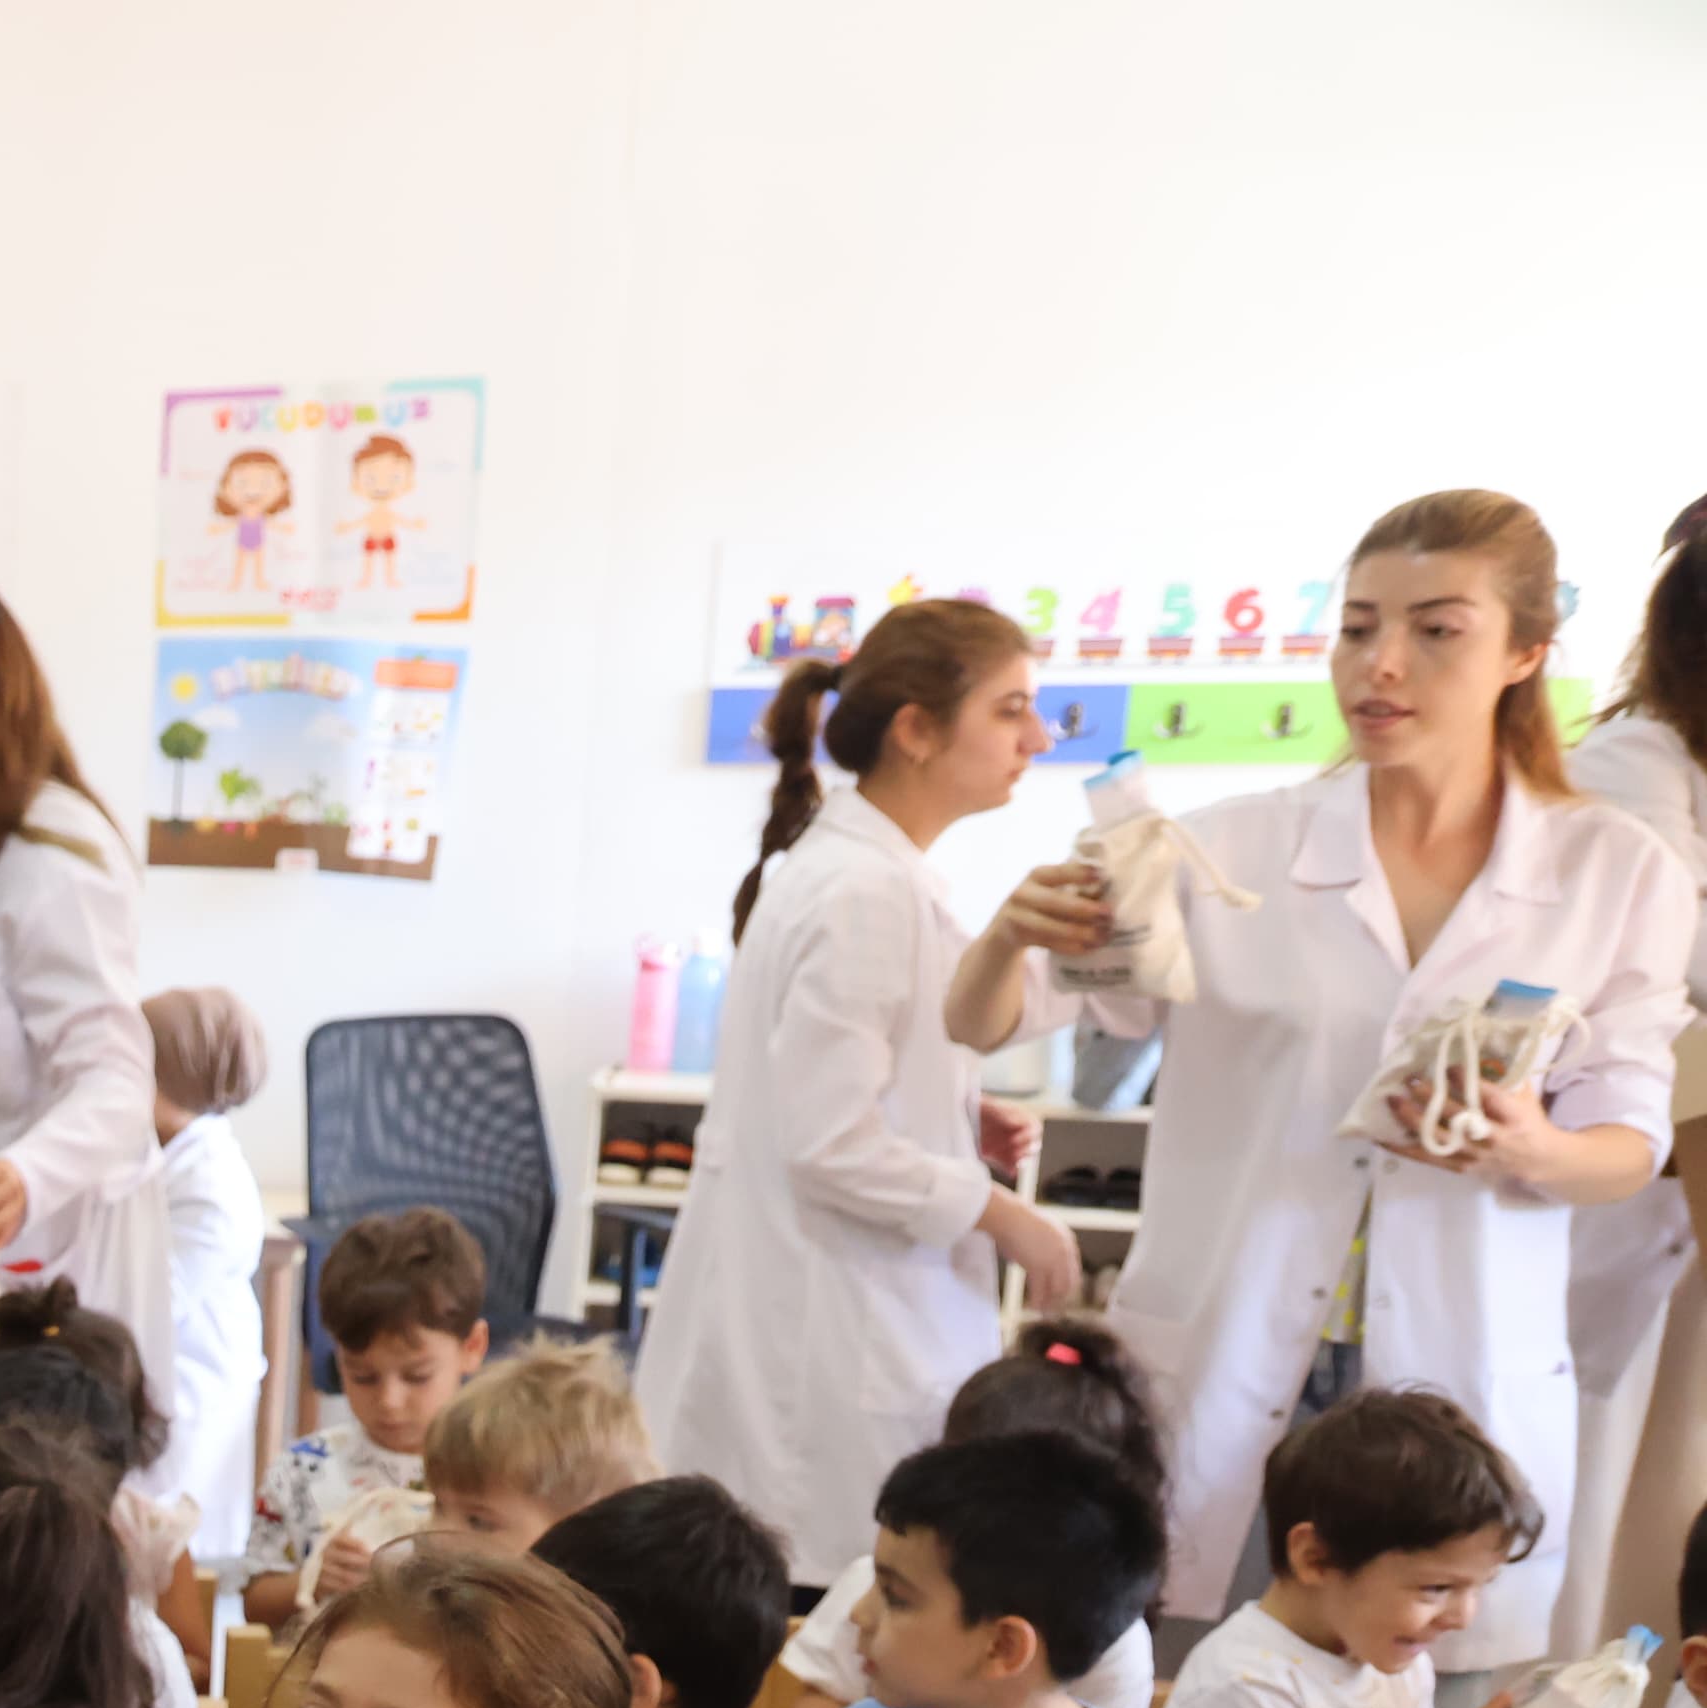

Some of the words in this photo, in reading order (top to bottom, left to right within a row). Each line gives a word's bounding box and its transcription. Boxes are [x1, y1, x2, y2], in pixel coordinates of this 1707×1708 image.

[1024, 587, 1059, 634] 3
[1079, 586, 1122, 634] 4
[1156, 583, 1197, 636] 5
[1223, 587, 1264, 634] 6
[1297, 580, 1334, 635] 7
